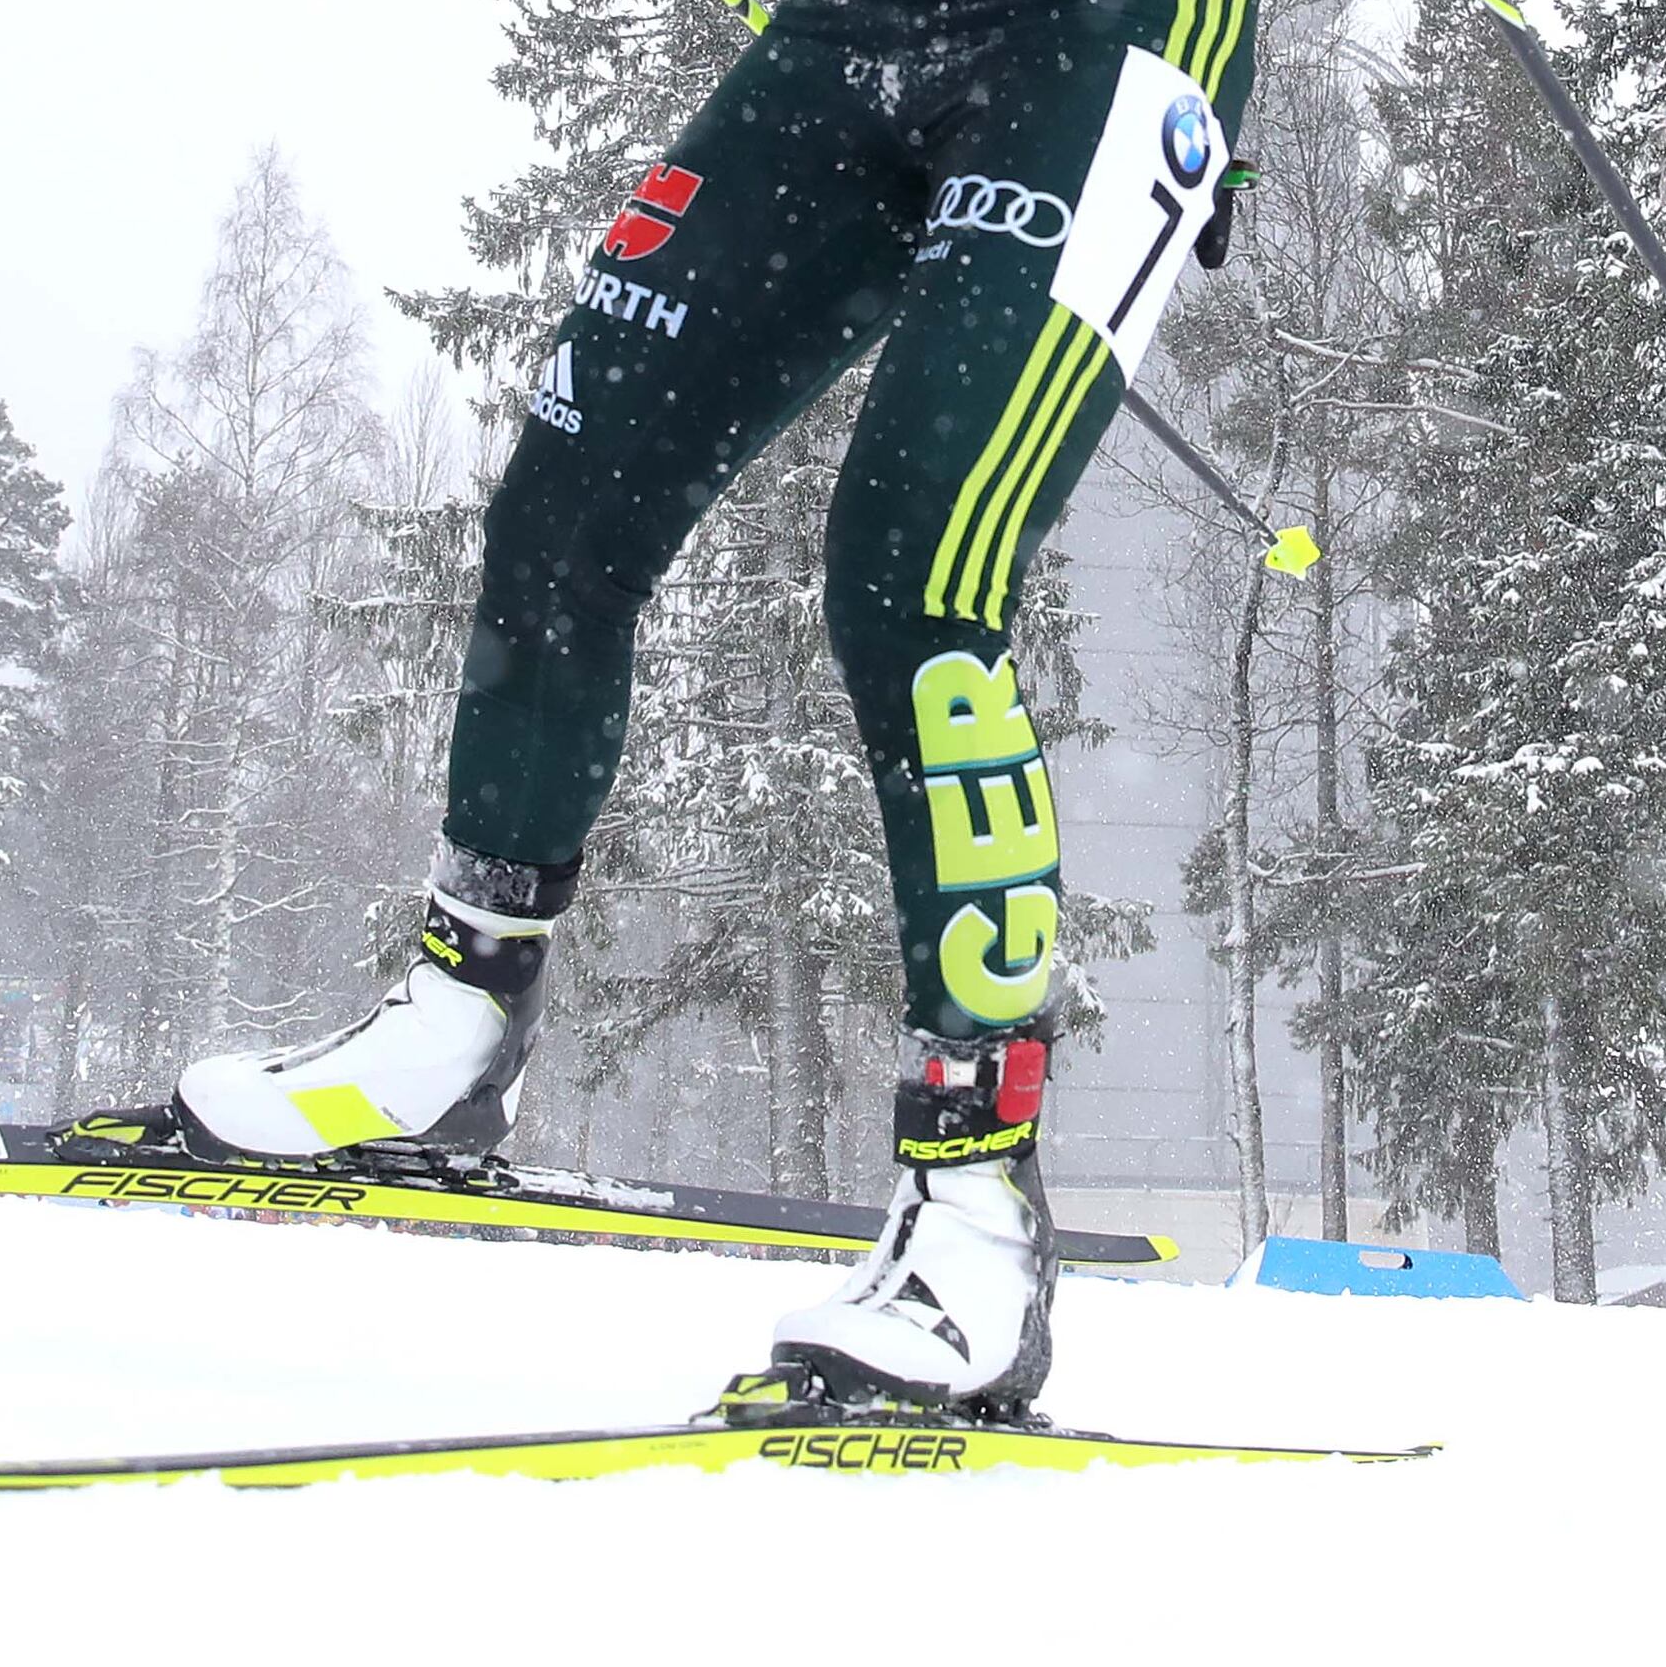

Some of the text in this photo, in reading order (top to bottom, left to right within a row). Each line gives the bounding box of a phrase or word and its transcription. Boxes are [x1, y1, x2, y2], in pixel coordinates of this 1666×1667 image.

[1107, 177, 1185, 334] 7
[574, 265, 689, 340] ÜRTH
[912, 650, 1060, 1027] GER
[899, 1123, 1033, 1161] FISCHER
[61, 1171, 367, 1211] FISCHER
[757, 1433, 967, 1471] FISCHER
